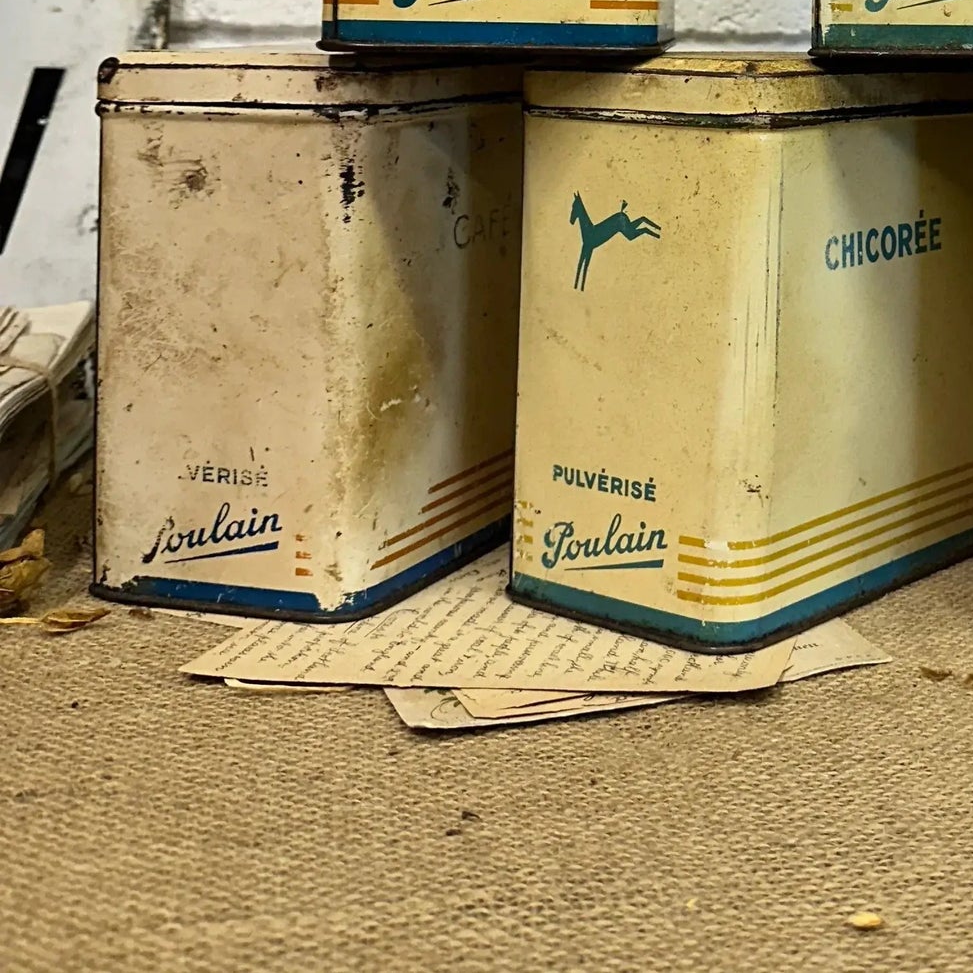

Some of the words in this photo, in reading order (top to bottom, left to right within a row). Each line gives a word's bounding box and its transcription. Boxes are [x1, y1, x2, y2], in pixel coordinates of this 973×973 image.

[824, 209, 942, 271] CHICORÉE
[552, 464, 657, 503] PULVÉRISÉ
[541, 512, 668, 570] Poulain
